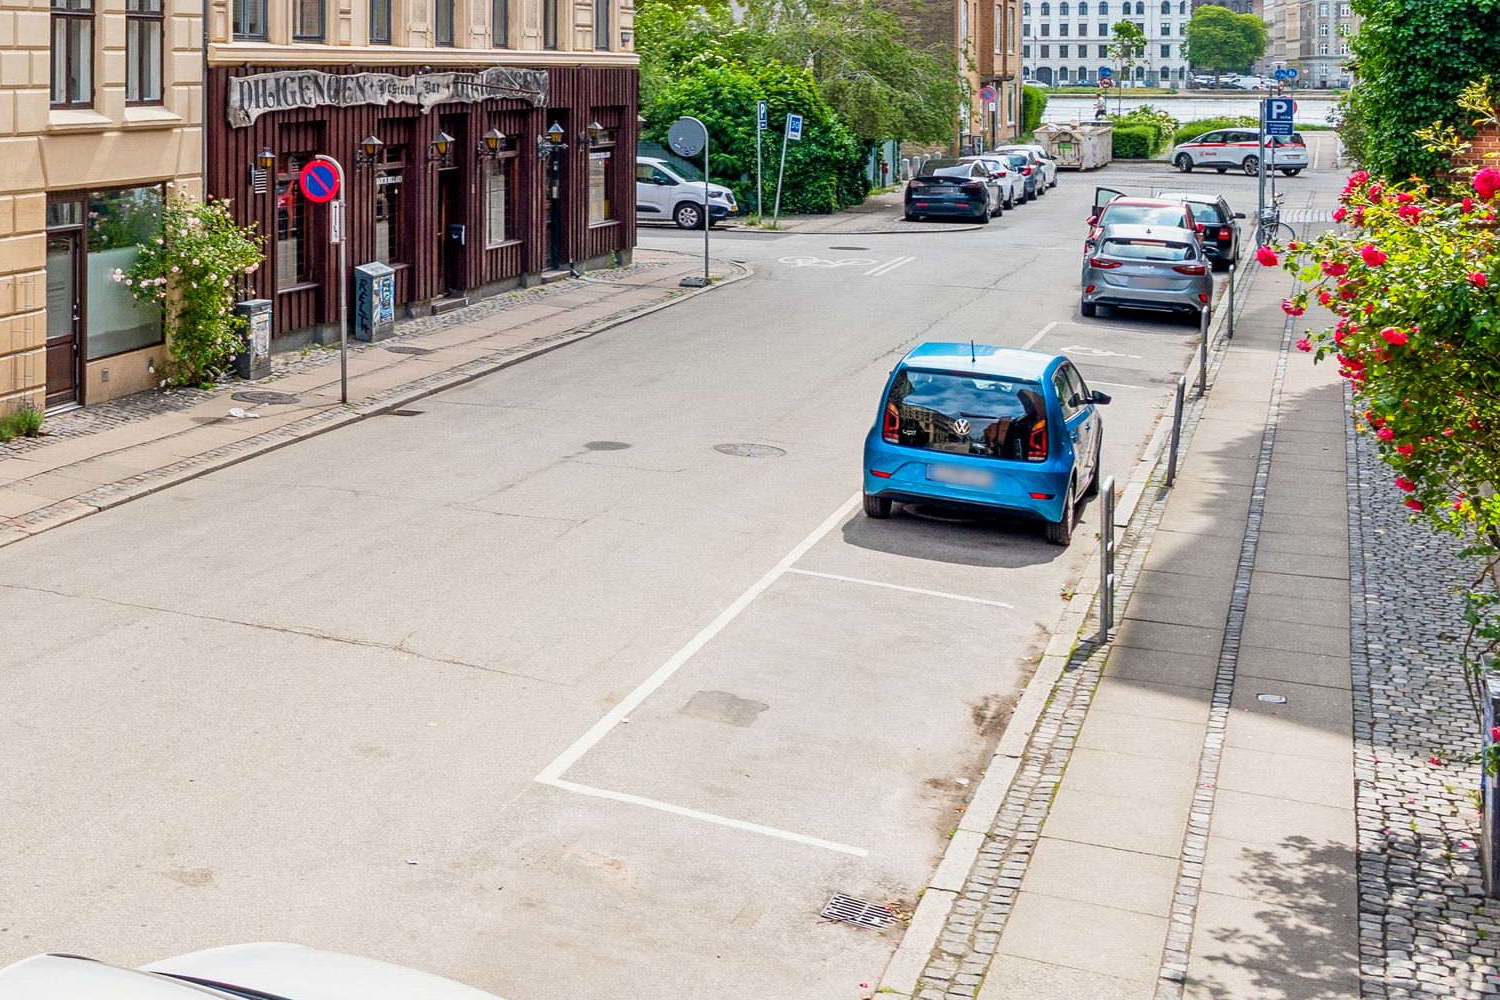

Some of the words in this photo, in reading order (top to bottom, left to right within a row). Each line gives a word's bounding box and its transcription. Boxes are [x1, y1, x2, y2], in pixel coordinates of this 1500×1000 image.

[239, 75, 366, 111] DILIGENCEN
[760, 103, 766, 119] P
[1272, 101, 1288, 119] P
[791, 120, 800, 130] 30
